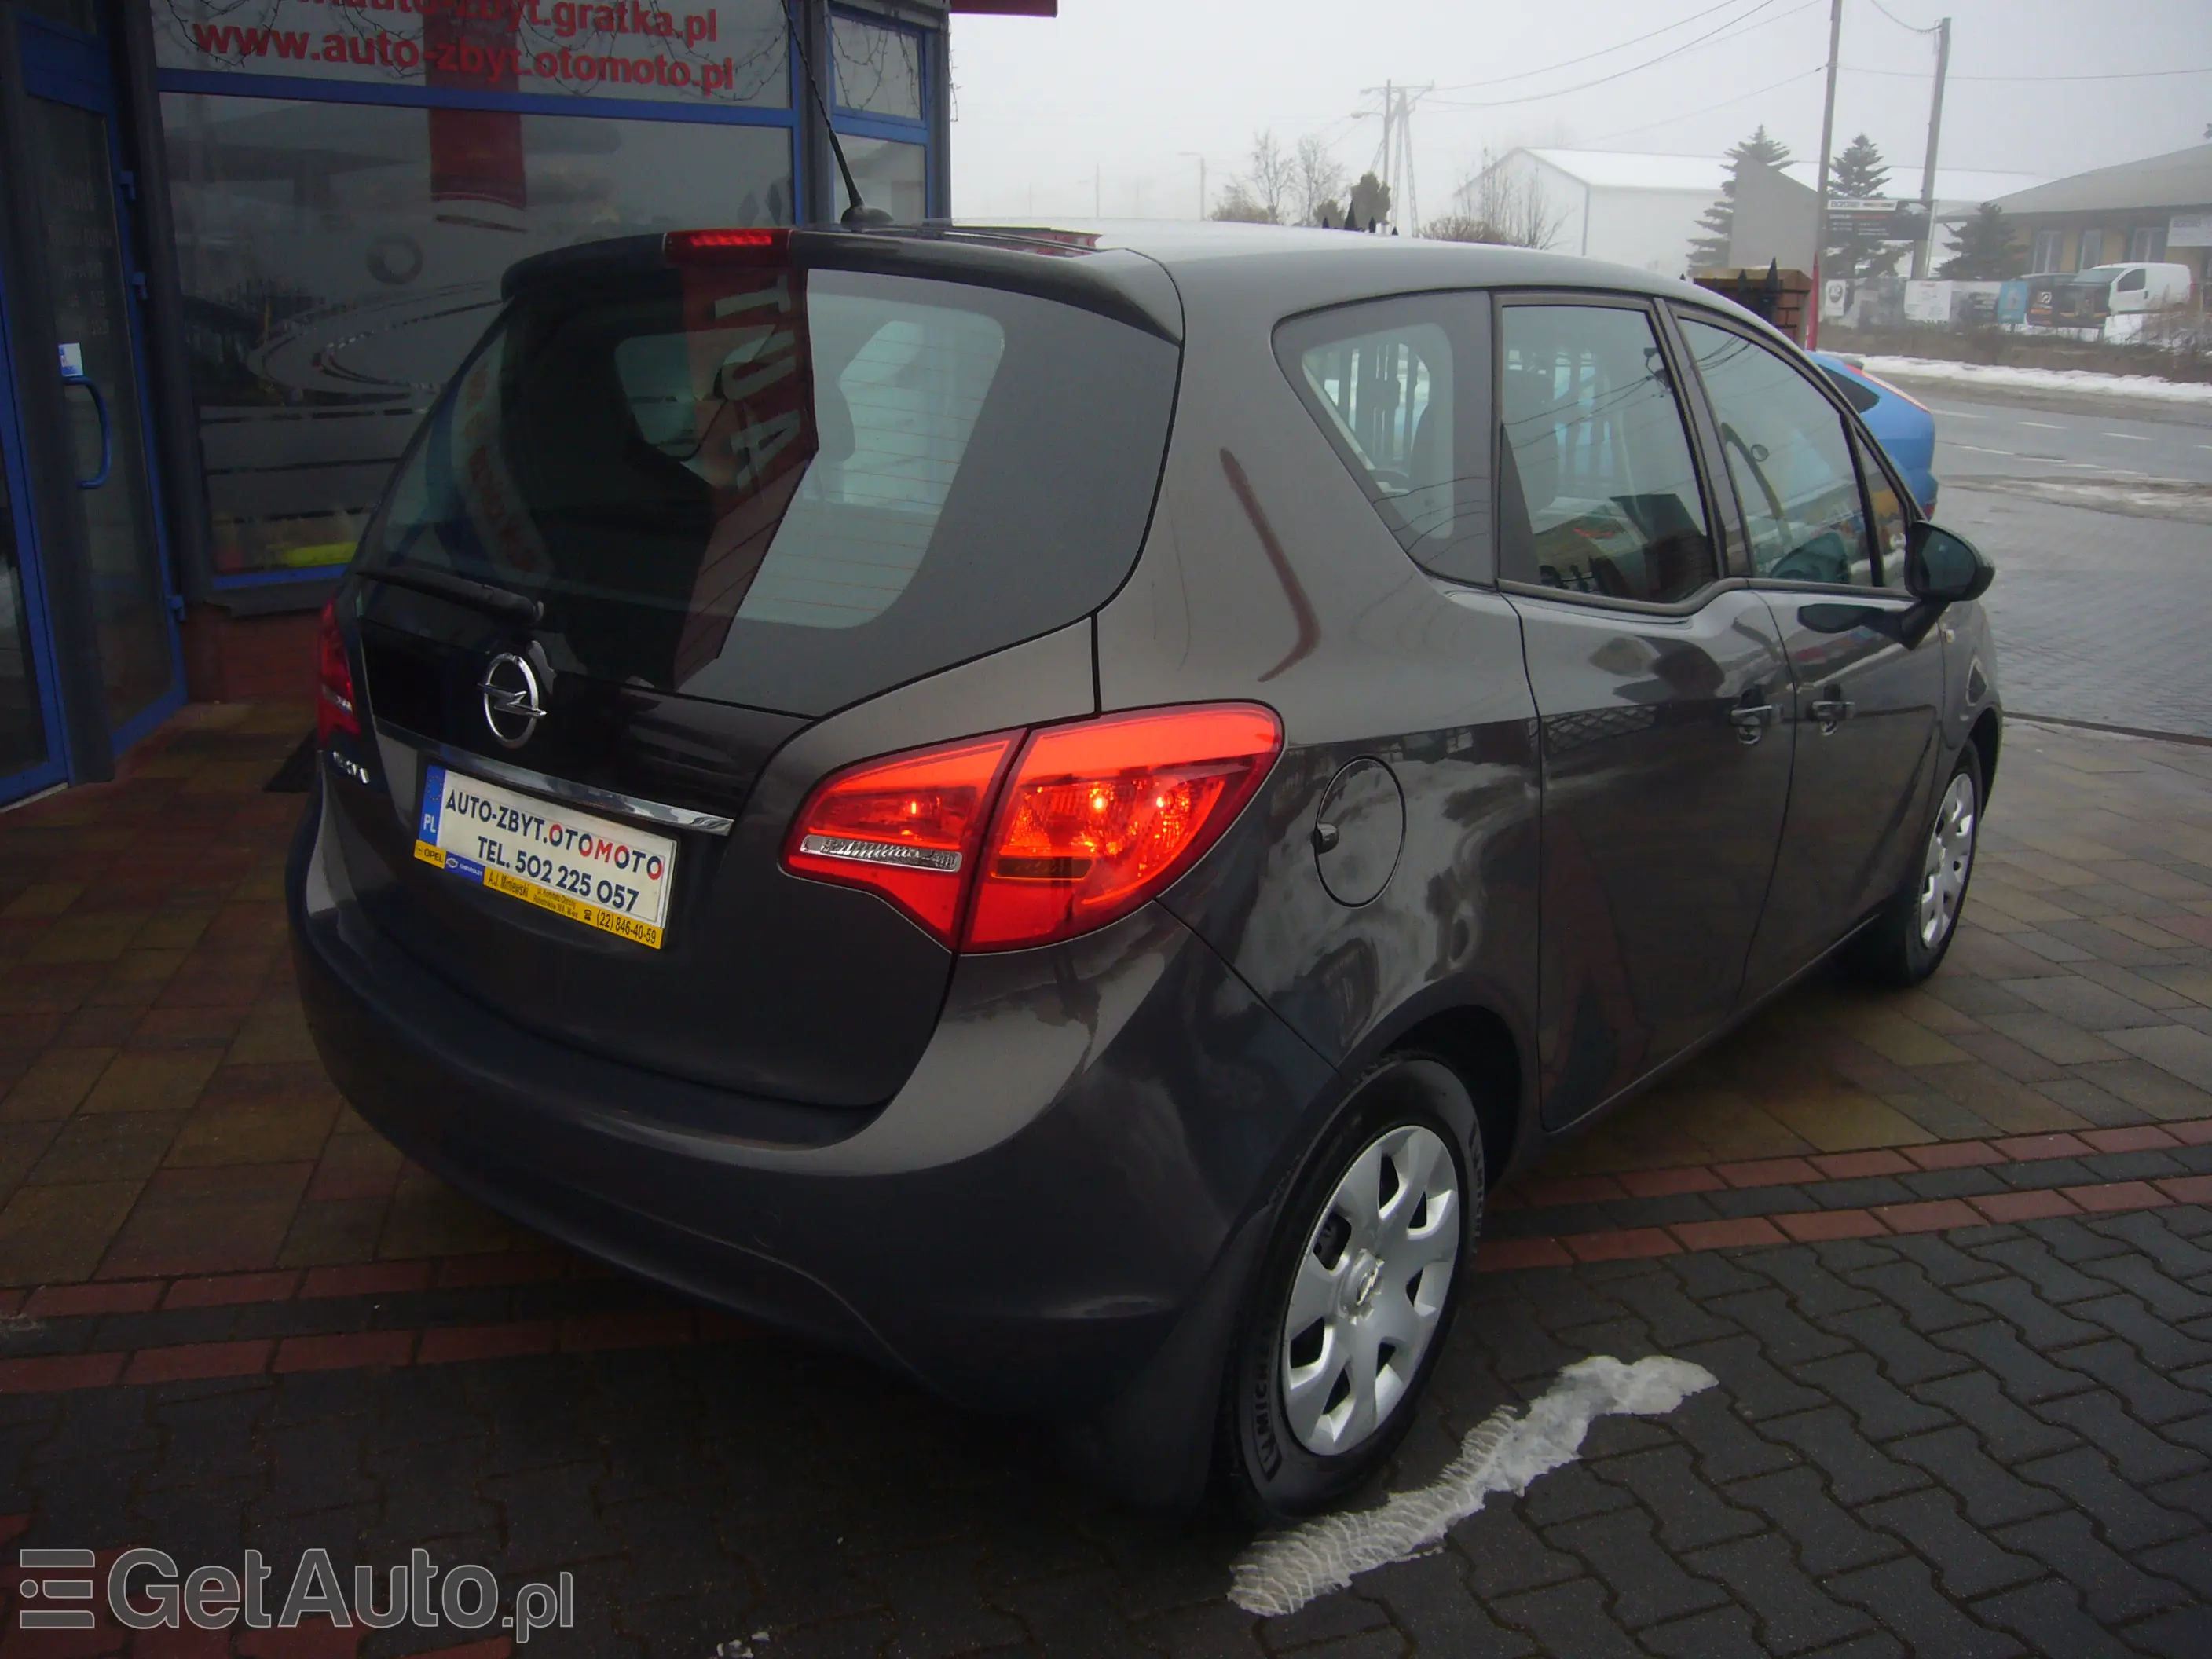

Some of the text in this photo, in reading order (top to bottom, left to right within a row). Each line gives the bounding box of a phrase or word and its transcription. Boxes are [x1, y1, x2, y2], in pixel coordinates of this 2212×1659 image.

[192, 23, 734, 96] www.auto-zbyt.otomoto.pl
[423, 814, 437, 833] PL
[445, 789, 664, 881] AUTO-ZBYT.OTOMOTO
[423, 848, 444, 863] OPEL
[478, 835, 511, 868] TEL.
[515, 850, 552, 884] 502
[557, 866, 591, 896] 225
[597, 880, 640, 912] 057
[597, 909, 657, 944] (22) 846-40-59
